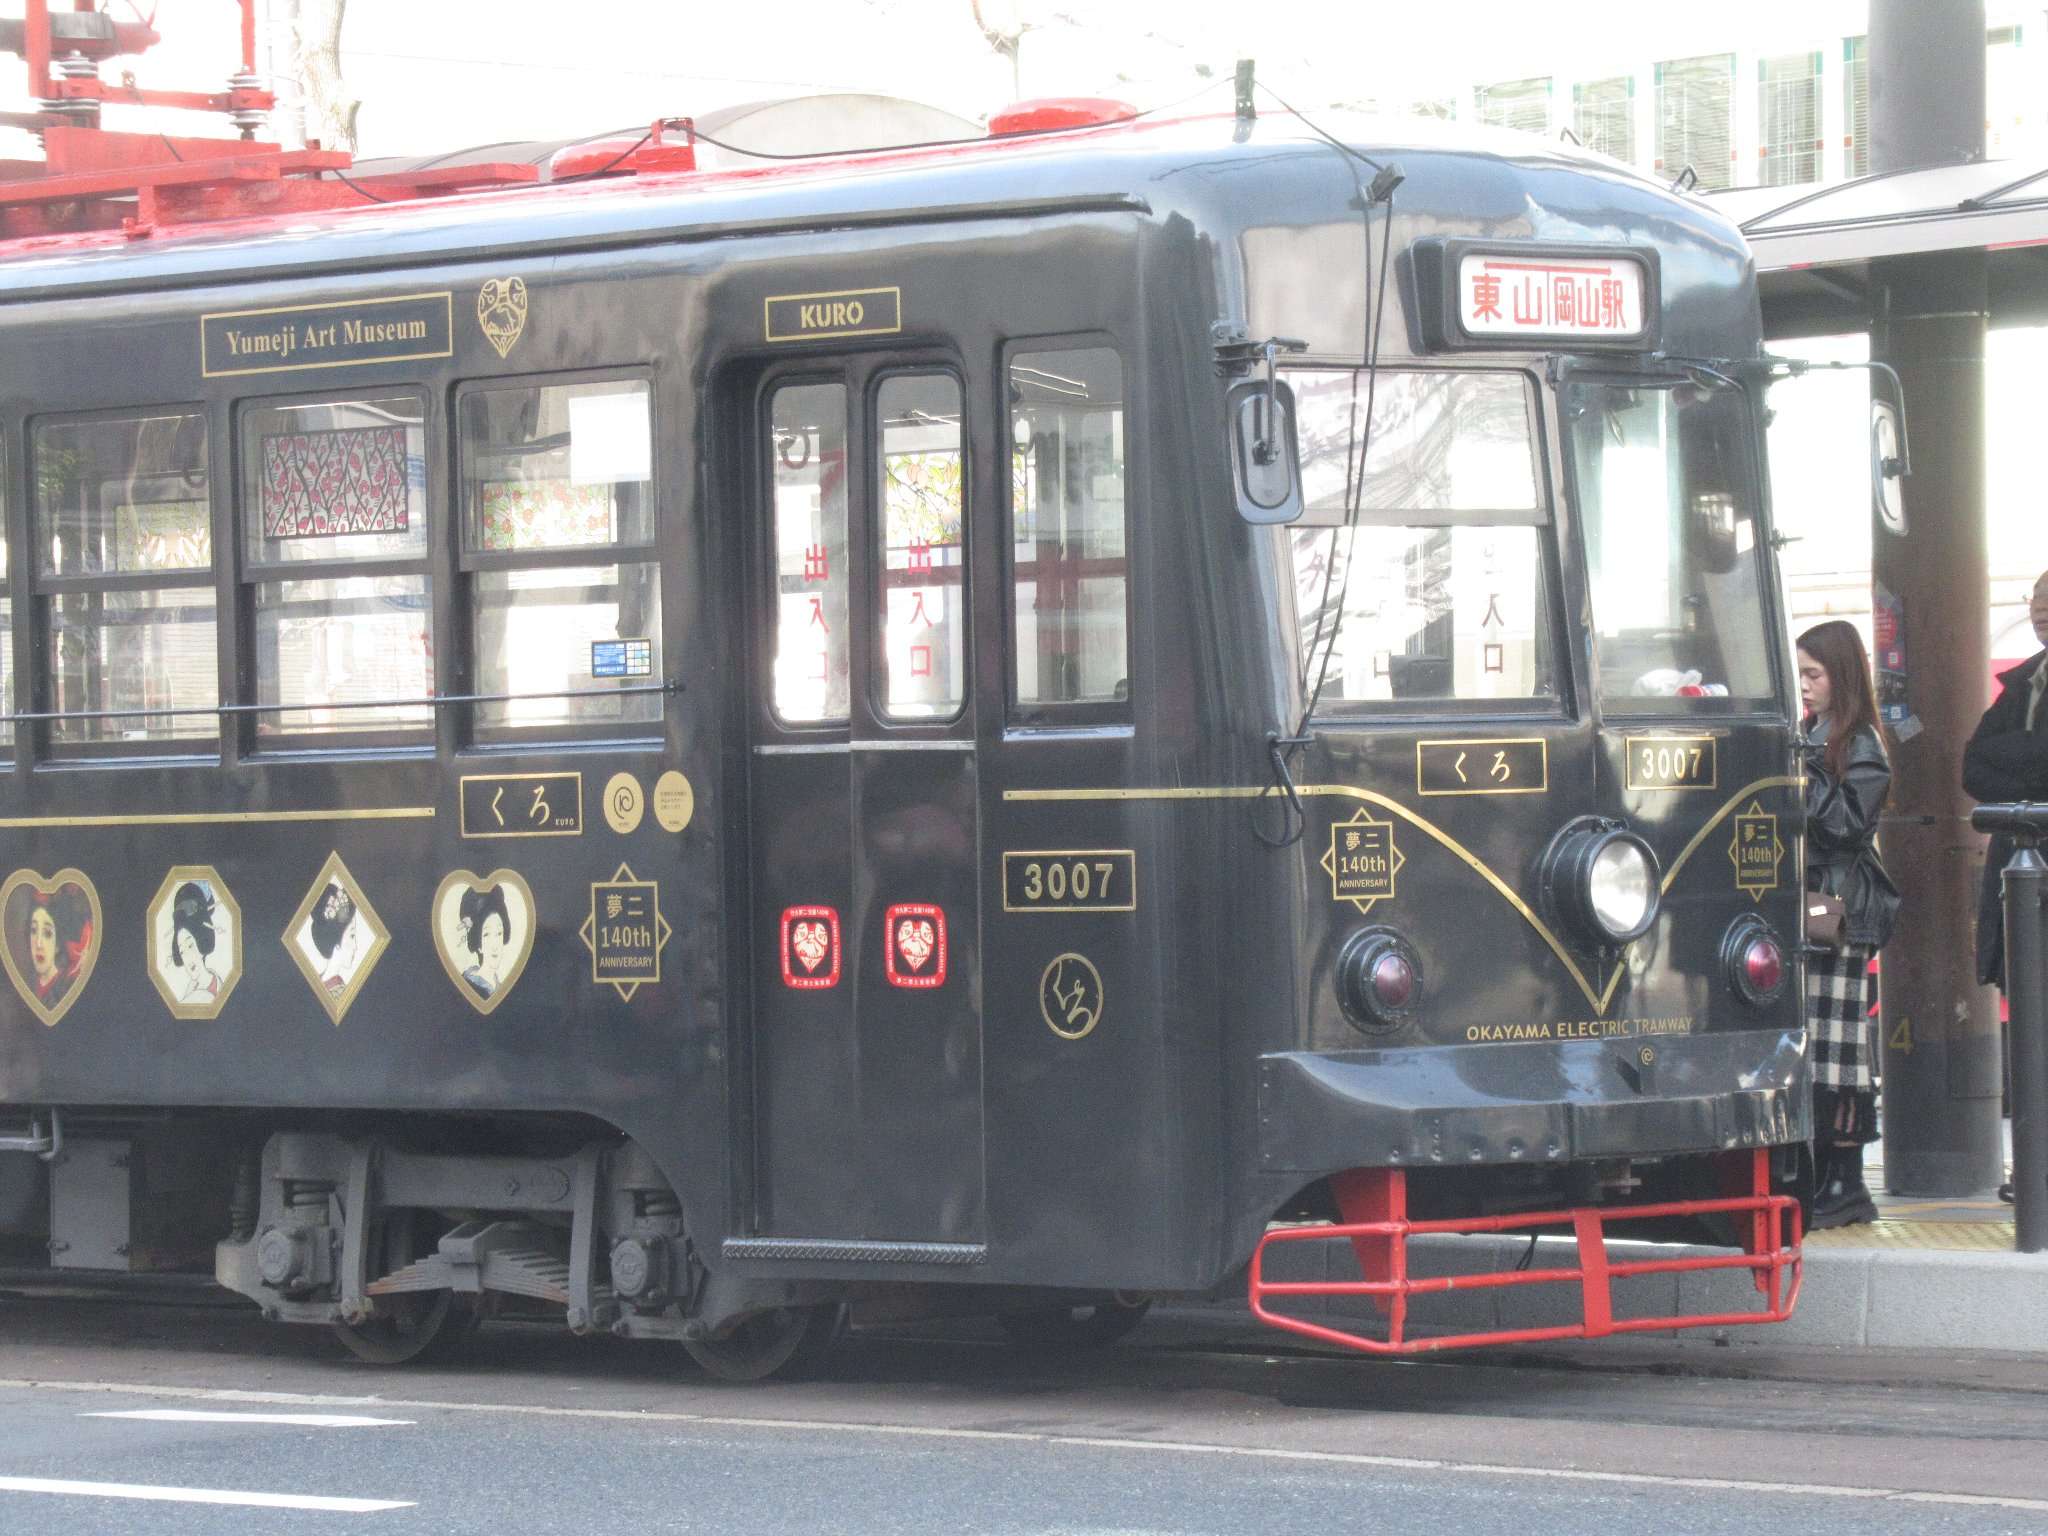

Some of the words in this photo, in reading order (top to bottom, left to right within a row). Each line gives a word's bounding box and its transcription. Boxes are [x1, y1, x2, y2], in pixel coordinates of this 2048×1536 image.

[1472, 273, 1543, 325] 東山
[1554, 276, 1627, 329] 岡山駅
[801, 301, 864, 328] KURO
[226, 325, 296, 357] Yumeji
[303, 324, 337, 348] Art
[343, 319, 427, 345] Museum
[908, 536, 934, 677] 出入口
[1454, 750, 1511, 784] くろ
[1641, 748, 1703, 780] 3007
[490, 785, 551, 827] くろ
[1345, 831, 1380, 851] 夢二
[1340, 855, 1386, 873] 140th
[1741, 847, 1772, 863] 140th
[1024, 863, 1114, 900] 3007
[1340, 879, 1388, 889] ANNIVERSARY
[606, 894, 644, 919] 夢二
[601, 925, 651, 948] 140th
[600, 955, 654, 968] ANNIVERSARY
[1466, 1023, 1551, 1041] OKAYAMA
[1557, 1019, 1630, 1037] ELECTRIC
[1633, 1016, 1694, 1034] TRAMWAY
